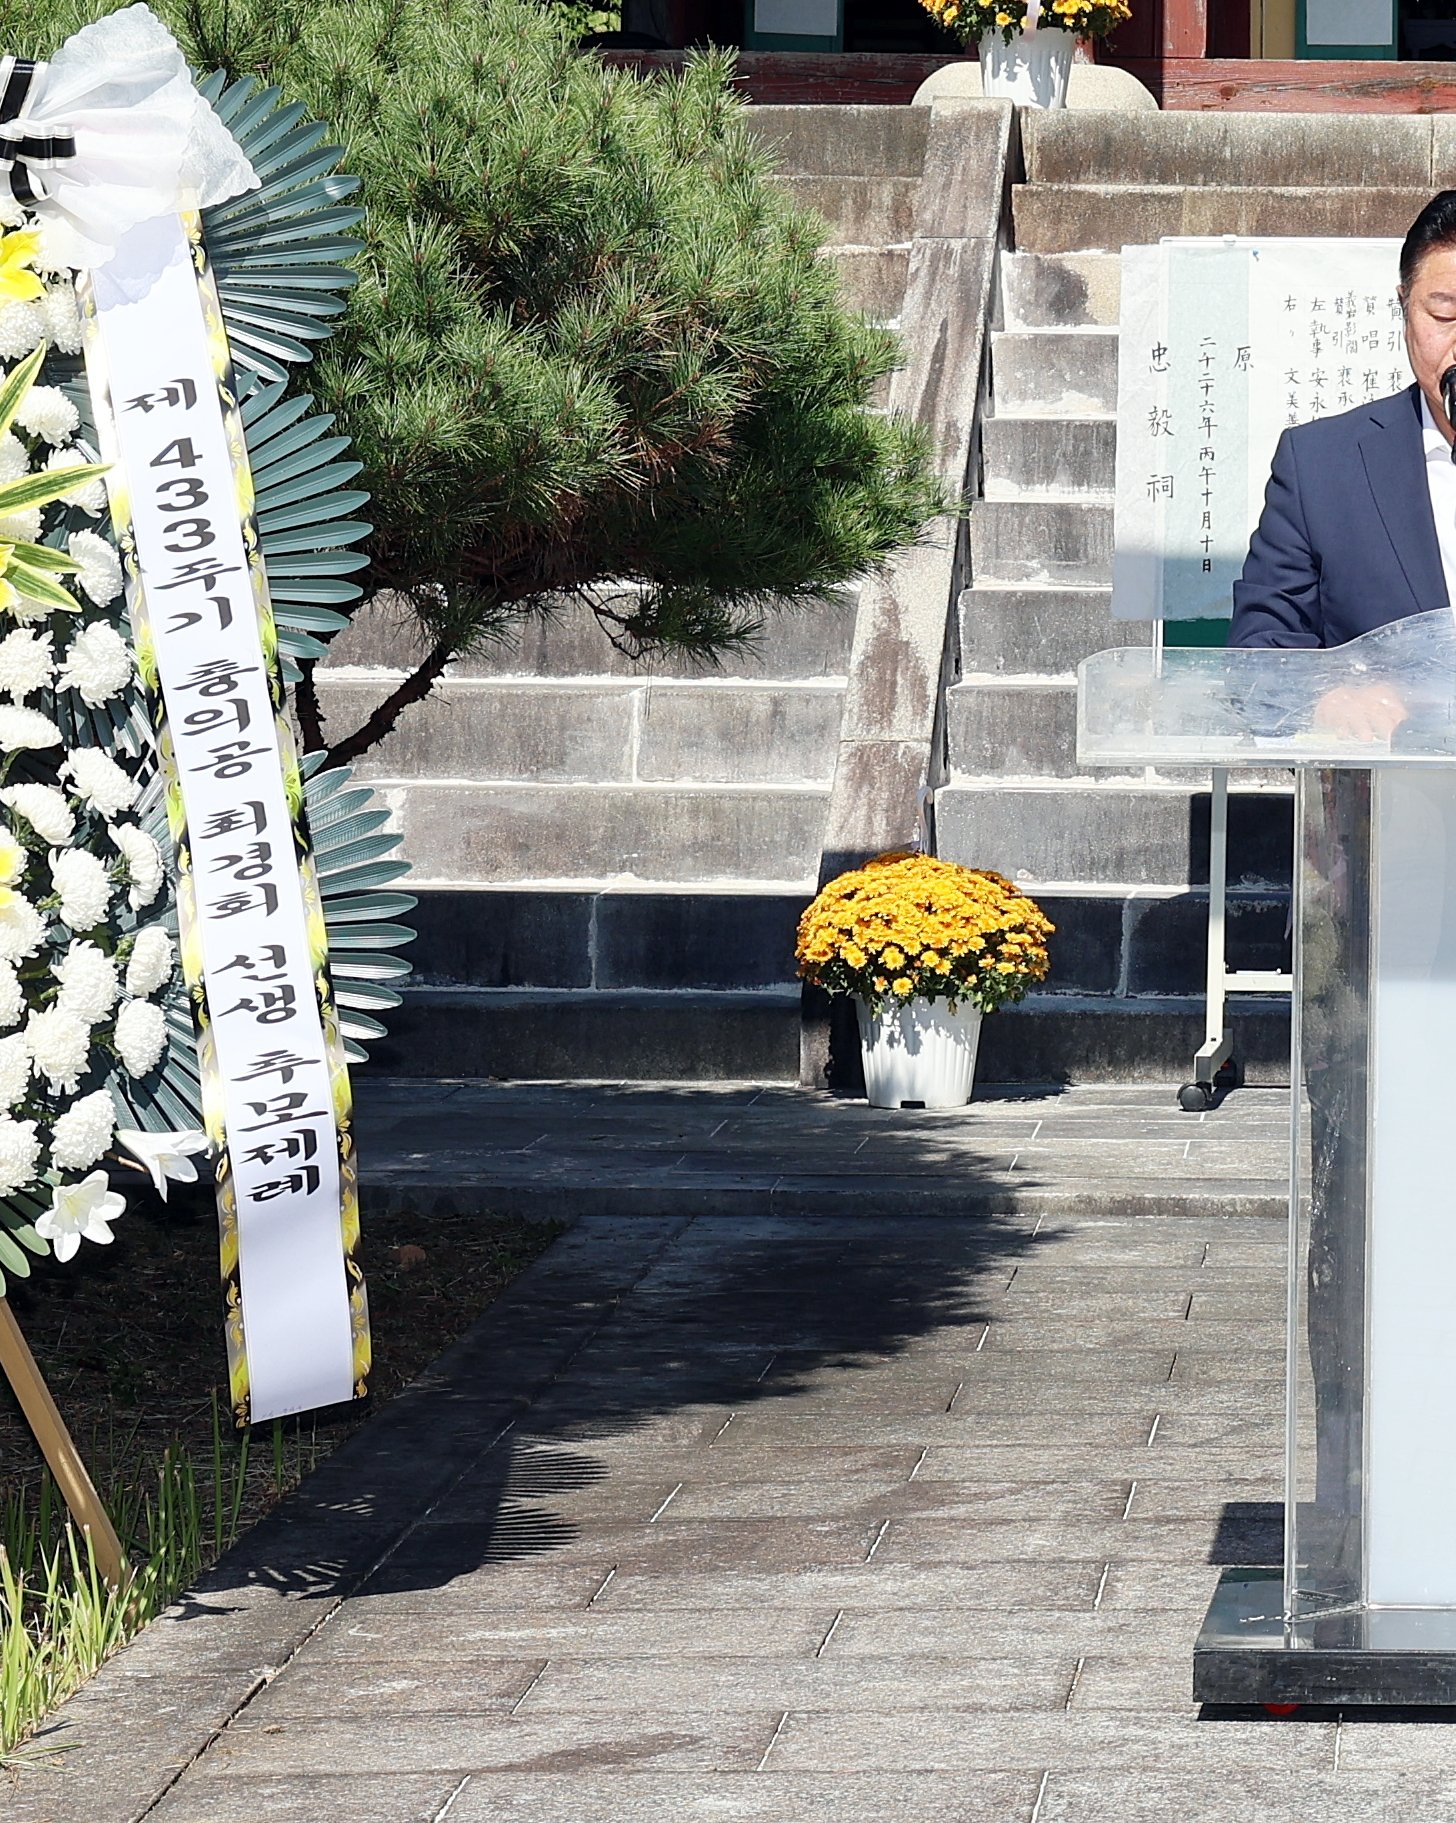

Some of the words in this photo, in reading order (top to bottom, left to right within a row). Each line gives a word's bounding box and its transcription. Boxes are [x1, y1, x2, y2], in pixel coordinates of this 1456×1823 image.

[172, 659, 272, 779] 충의공
[199, 800, 279, 921] 최경회
[211, 944, 298, 1025] 선생
[231, 1049, 329, 1203] 추모제례
